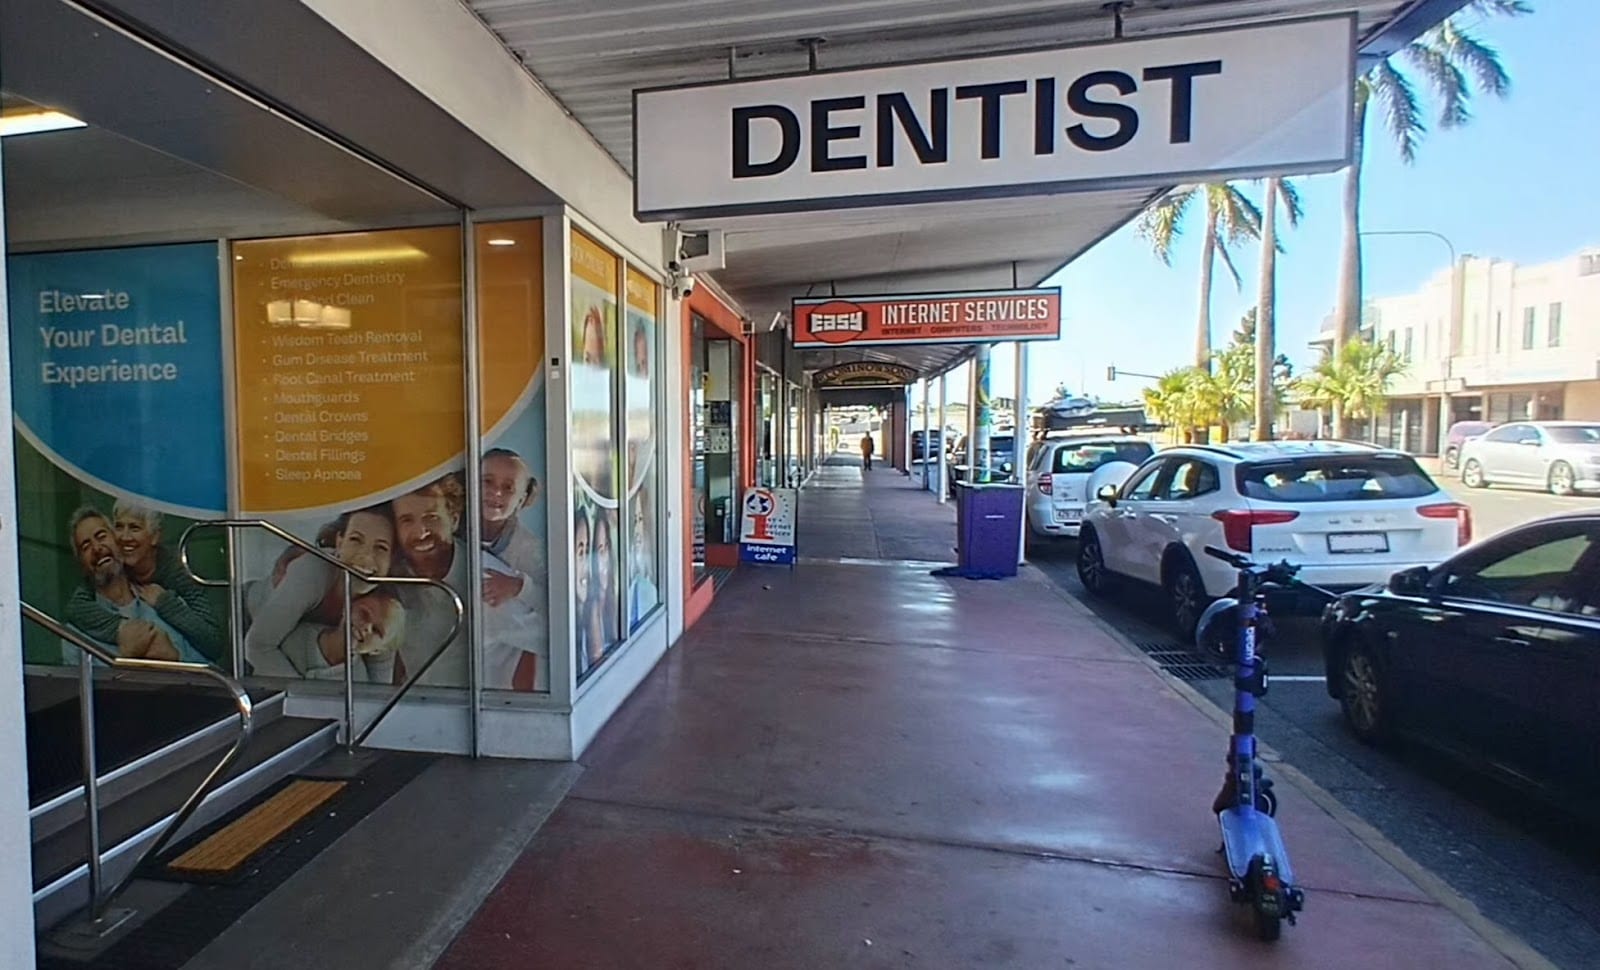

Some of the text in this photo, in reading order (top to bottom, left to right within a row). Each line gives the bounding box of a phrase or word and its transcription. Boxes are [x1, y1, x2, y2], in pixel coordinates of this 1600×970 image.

[731, 60, 1222, 179] DENTIST
[39, 289, 130, 313] Elevate
[881, 299, 1049, 325] INTERNET SERVICES
[40, 321, 188, 348] Your Dental
[272, 355, 303, 367] Gum
[359, 350, 429, 364] Treatment
[41, 359, 177, 388] Experience
[345, 370, 416, 384] Treatment
[747, 544, 786, 554] internet
[754, 553, 778, 561] cafe
